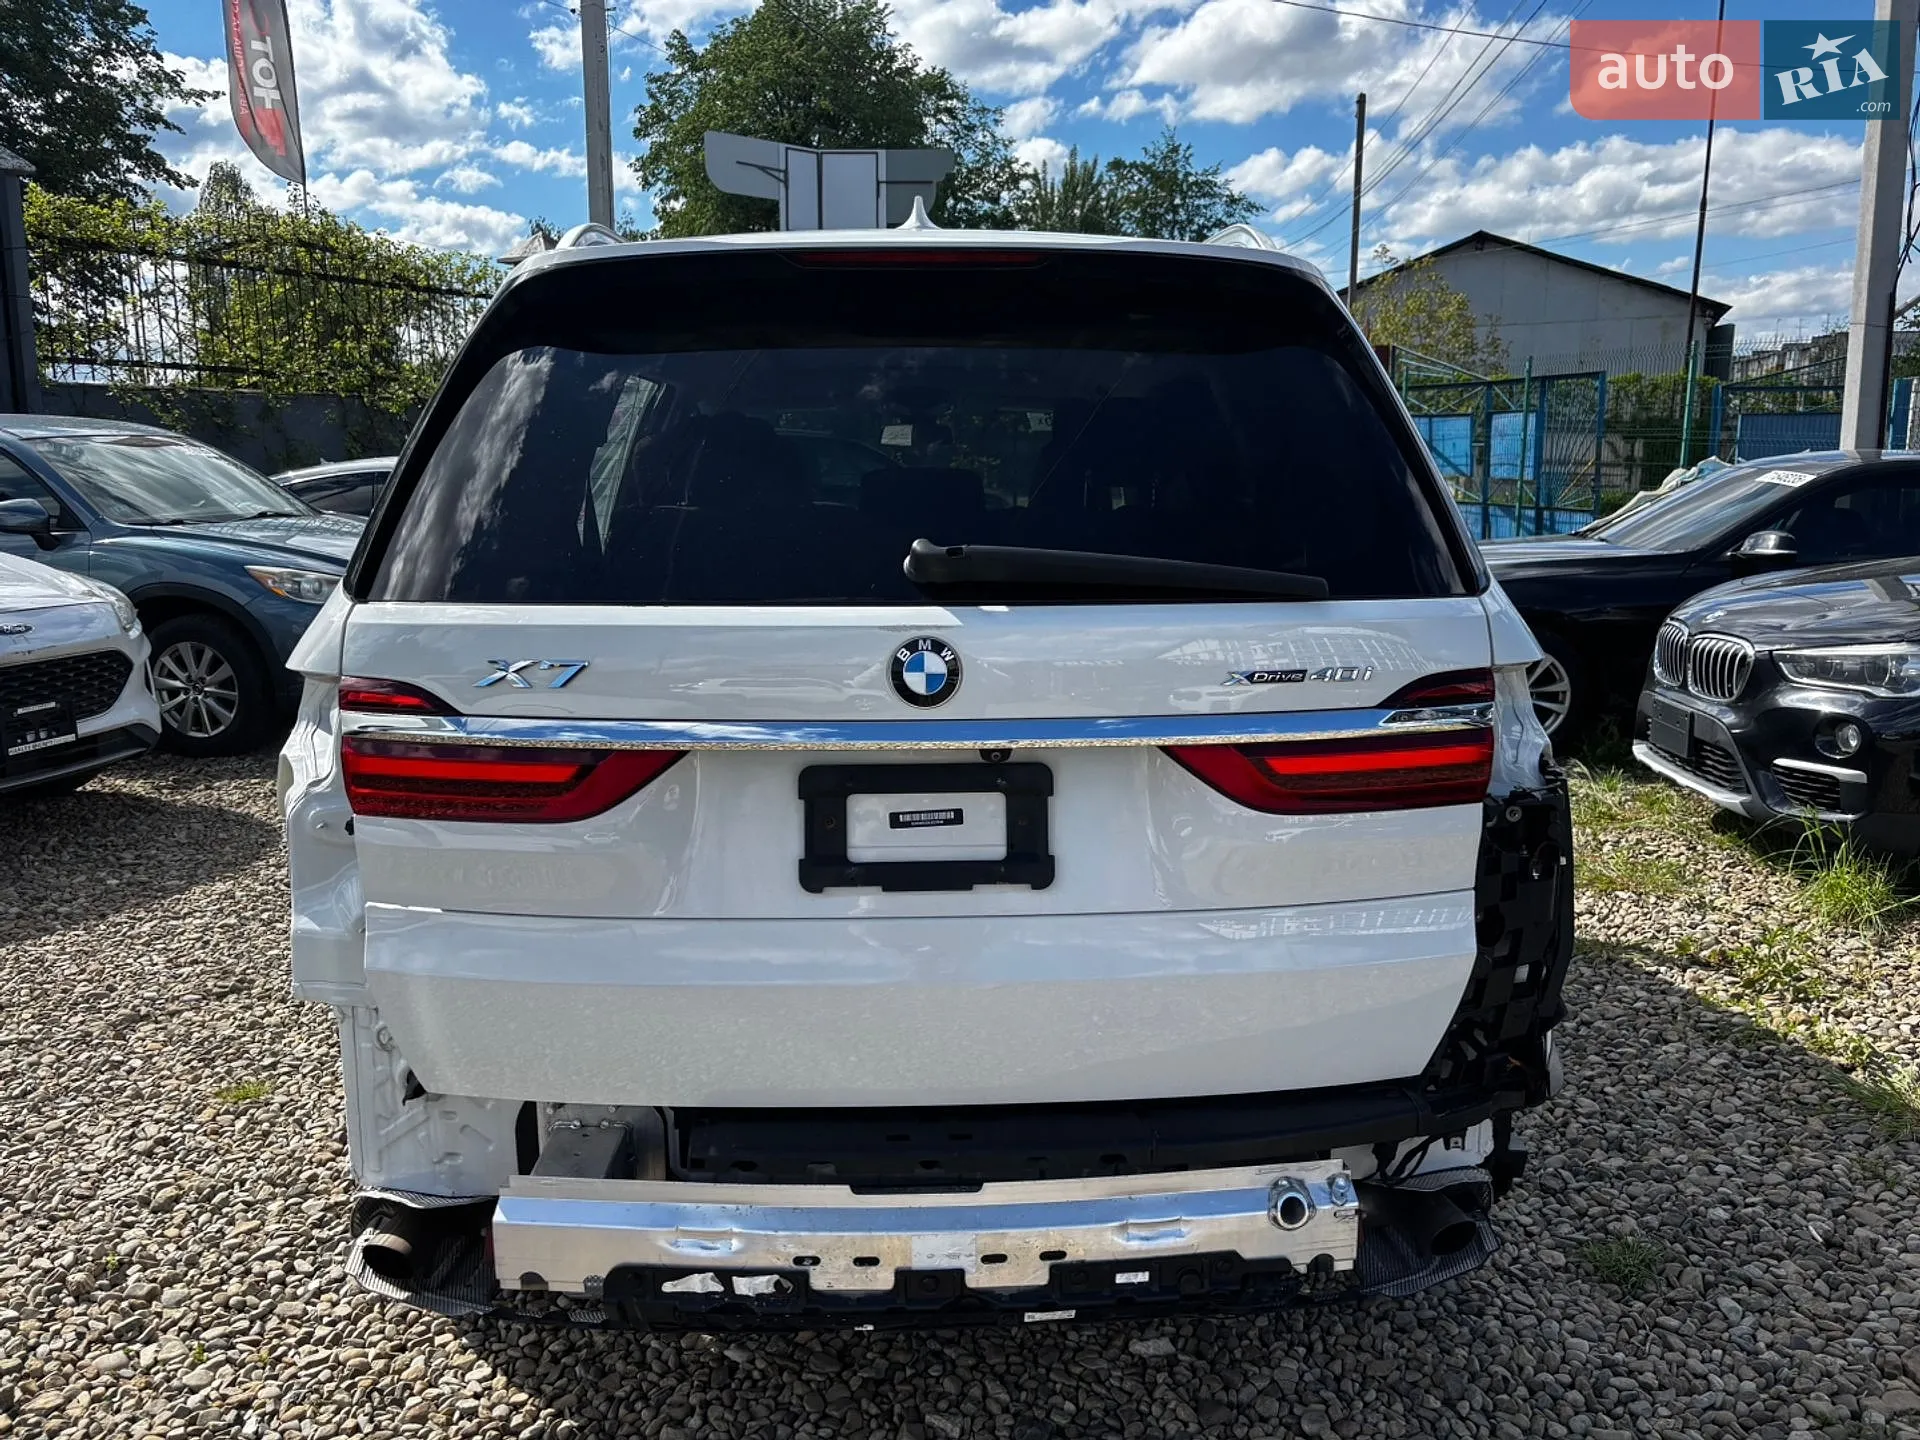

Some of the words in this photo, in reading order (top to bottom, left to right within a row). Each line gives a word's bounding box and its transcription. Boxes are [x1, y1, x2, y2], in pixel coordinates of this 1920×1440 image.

[896, 638, 956, 662] BMW
[471, 659, 590, 689] X7
[1310, 666, 1375, 683] 40i
